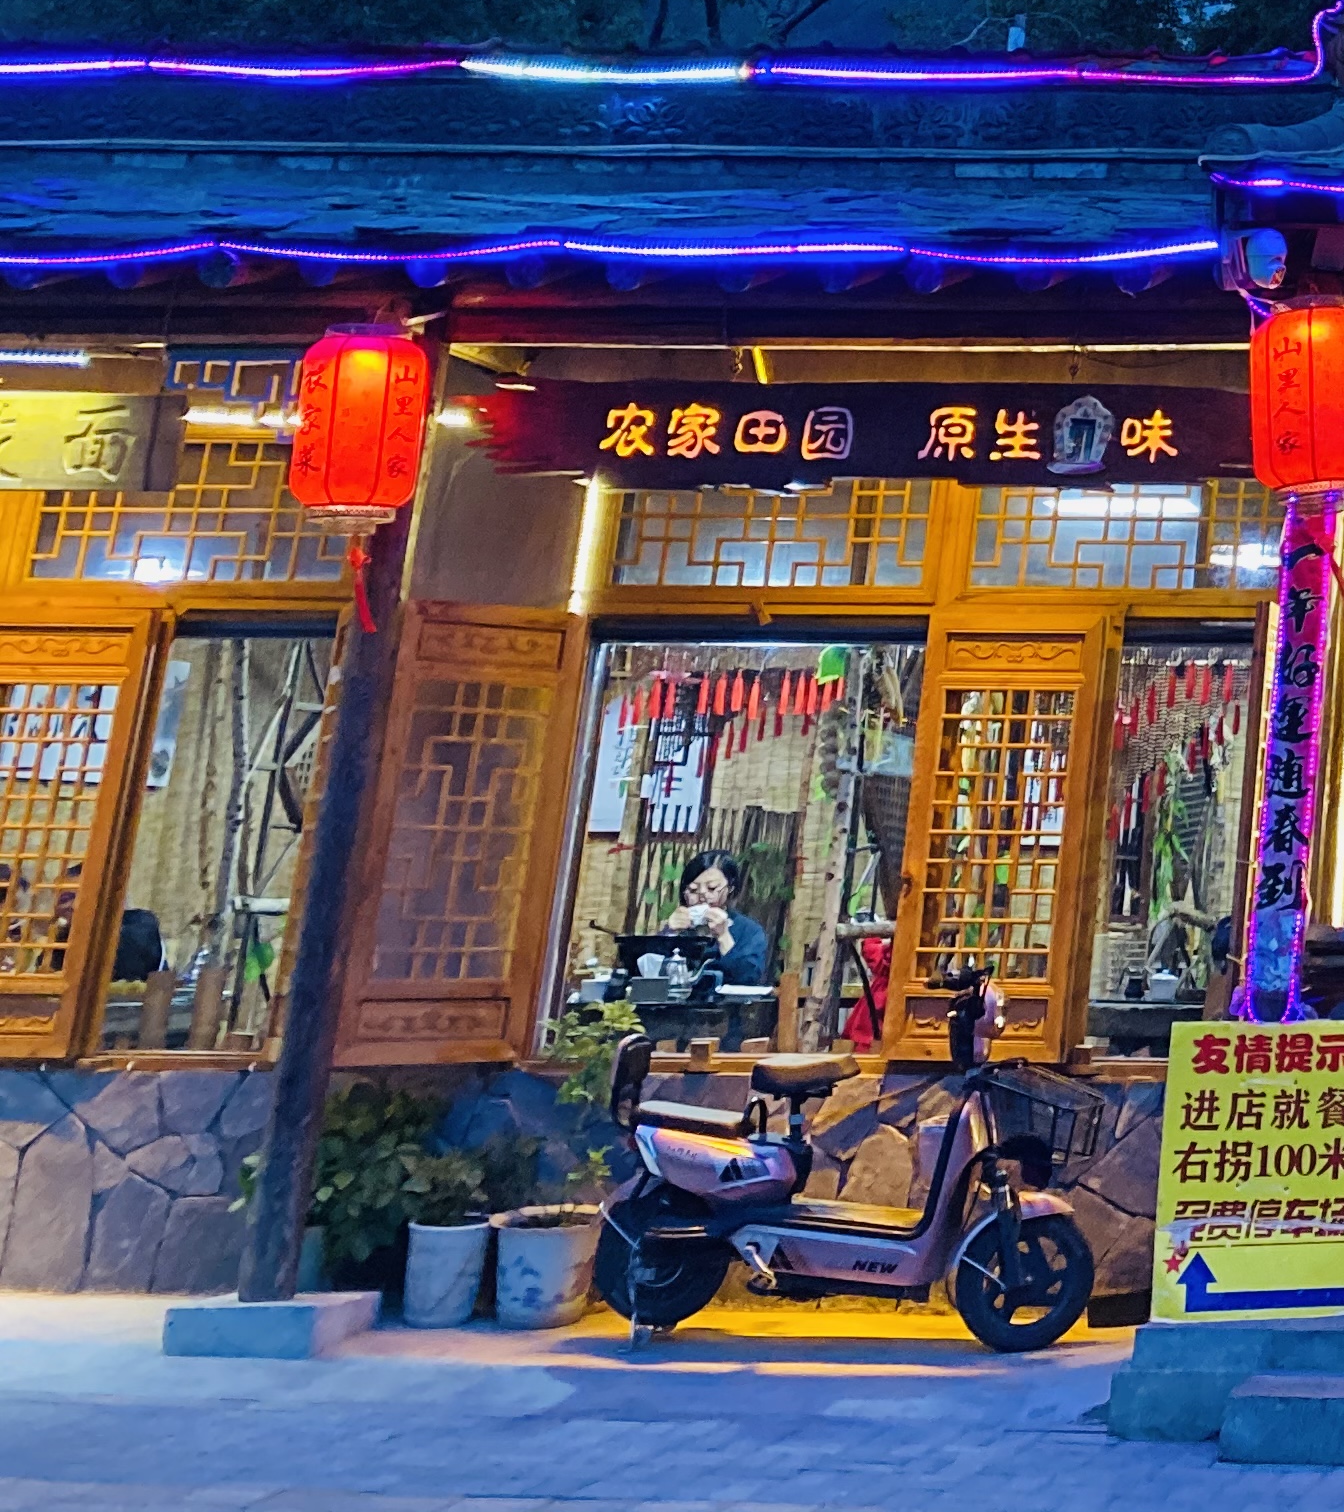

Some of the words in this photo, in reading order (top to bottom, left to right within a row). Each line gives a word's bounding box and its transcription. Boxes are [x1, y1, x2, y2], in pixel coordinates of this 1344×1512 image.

[386, 364, 419, 479] 山里人家
[599, 402, 855, 461] 农家田园
[917, 405, 1178, 464] 原生味
[1273, 336, 1305, 456] 山里人家
[852, 1259, 899, 1274] NEW
